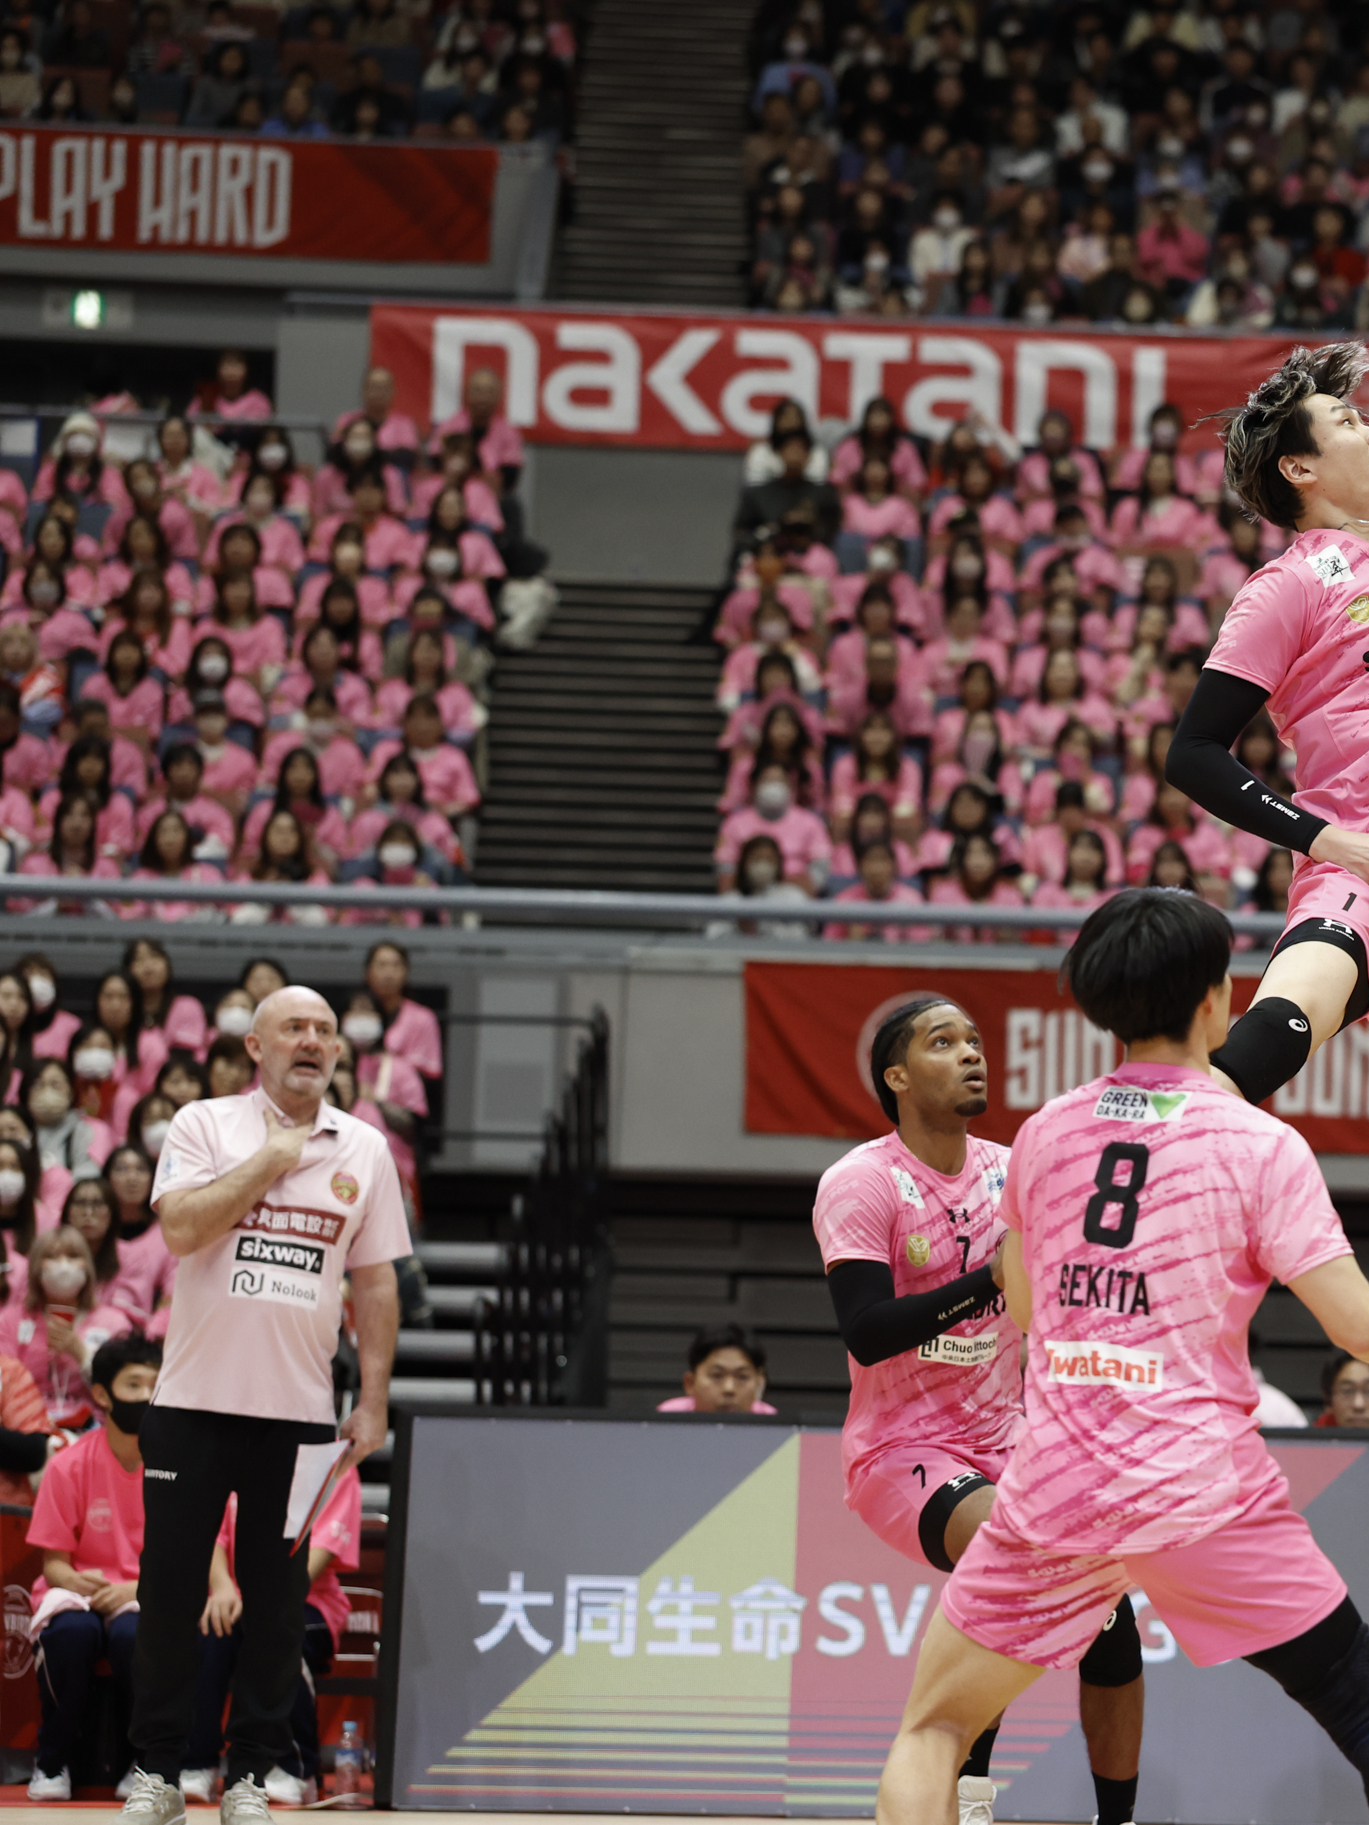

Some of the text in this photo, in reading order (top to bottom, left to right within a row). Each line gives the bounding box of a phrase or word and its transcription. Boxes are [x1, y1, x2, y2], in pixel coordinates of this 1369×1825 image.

[137, 139, 293, 248] HARD
[1342, 892, 1358, 912] 1
[1101, 1091, 1149, 1108] GREEN
[1095, 1104, 1147, 1120] DA-KA-RA
[1083, 1141, 1150, 1249] 8
[955, 1235, 971, 1274] 7
[271, 1280, 316, 1302] Nolook
[1058, 1263, 1150, 1316] SEKITA
[943, 1339, 973, 1354] Chuo
[912, 1463, 926, 1490] 7
